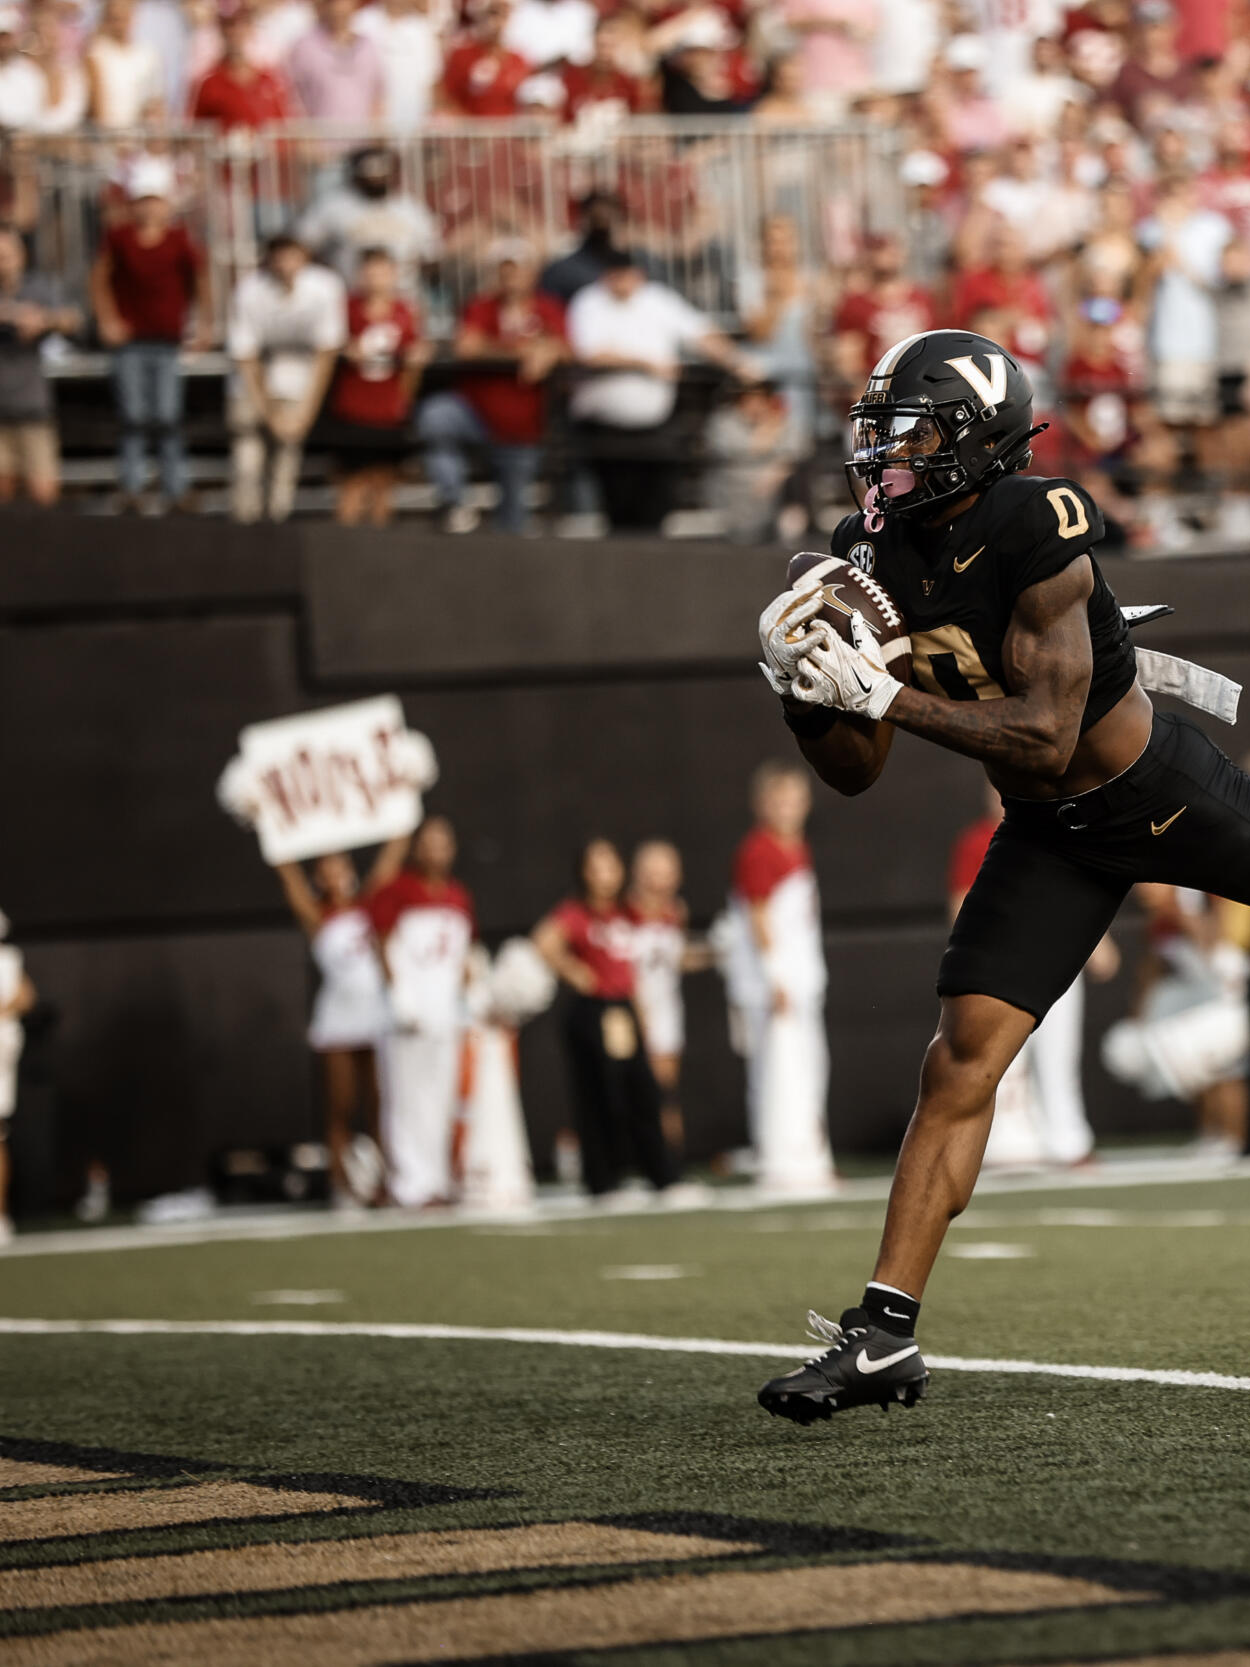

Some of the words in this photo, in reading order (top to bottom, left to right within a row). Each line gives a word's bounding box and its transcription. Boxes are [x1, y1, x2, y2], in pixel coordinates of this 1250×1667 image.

[944, 353, 1008, 407] V
[1046, 487, 1089, 540] 0
[849, 544, 874, 574] SEC
[921, 579, 936, 596] V
